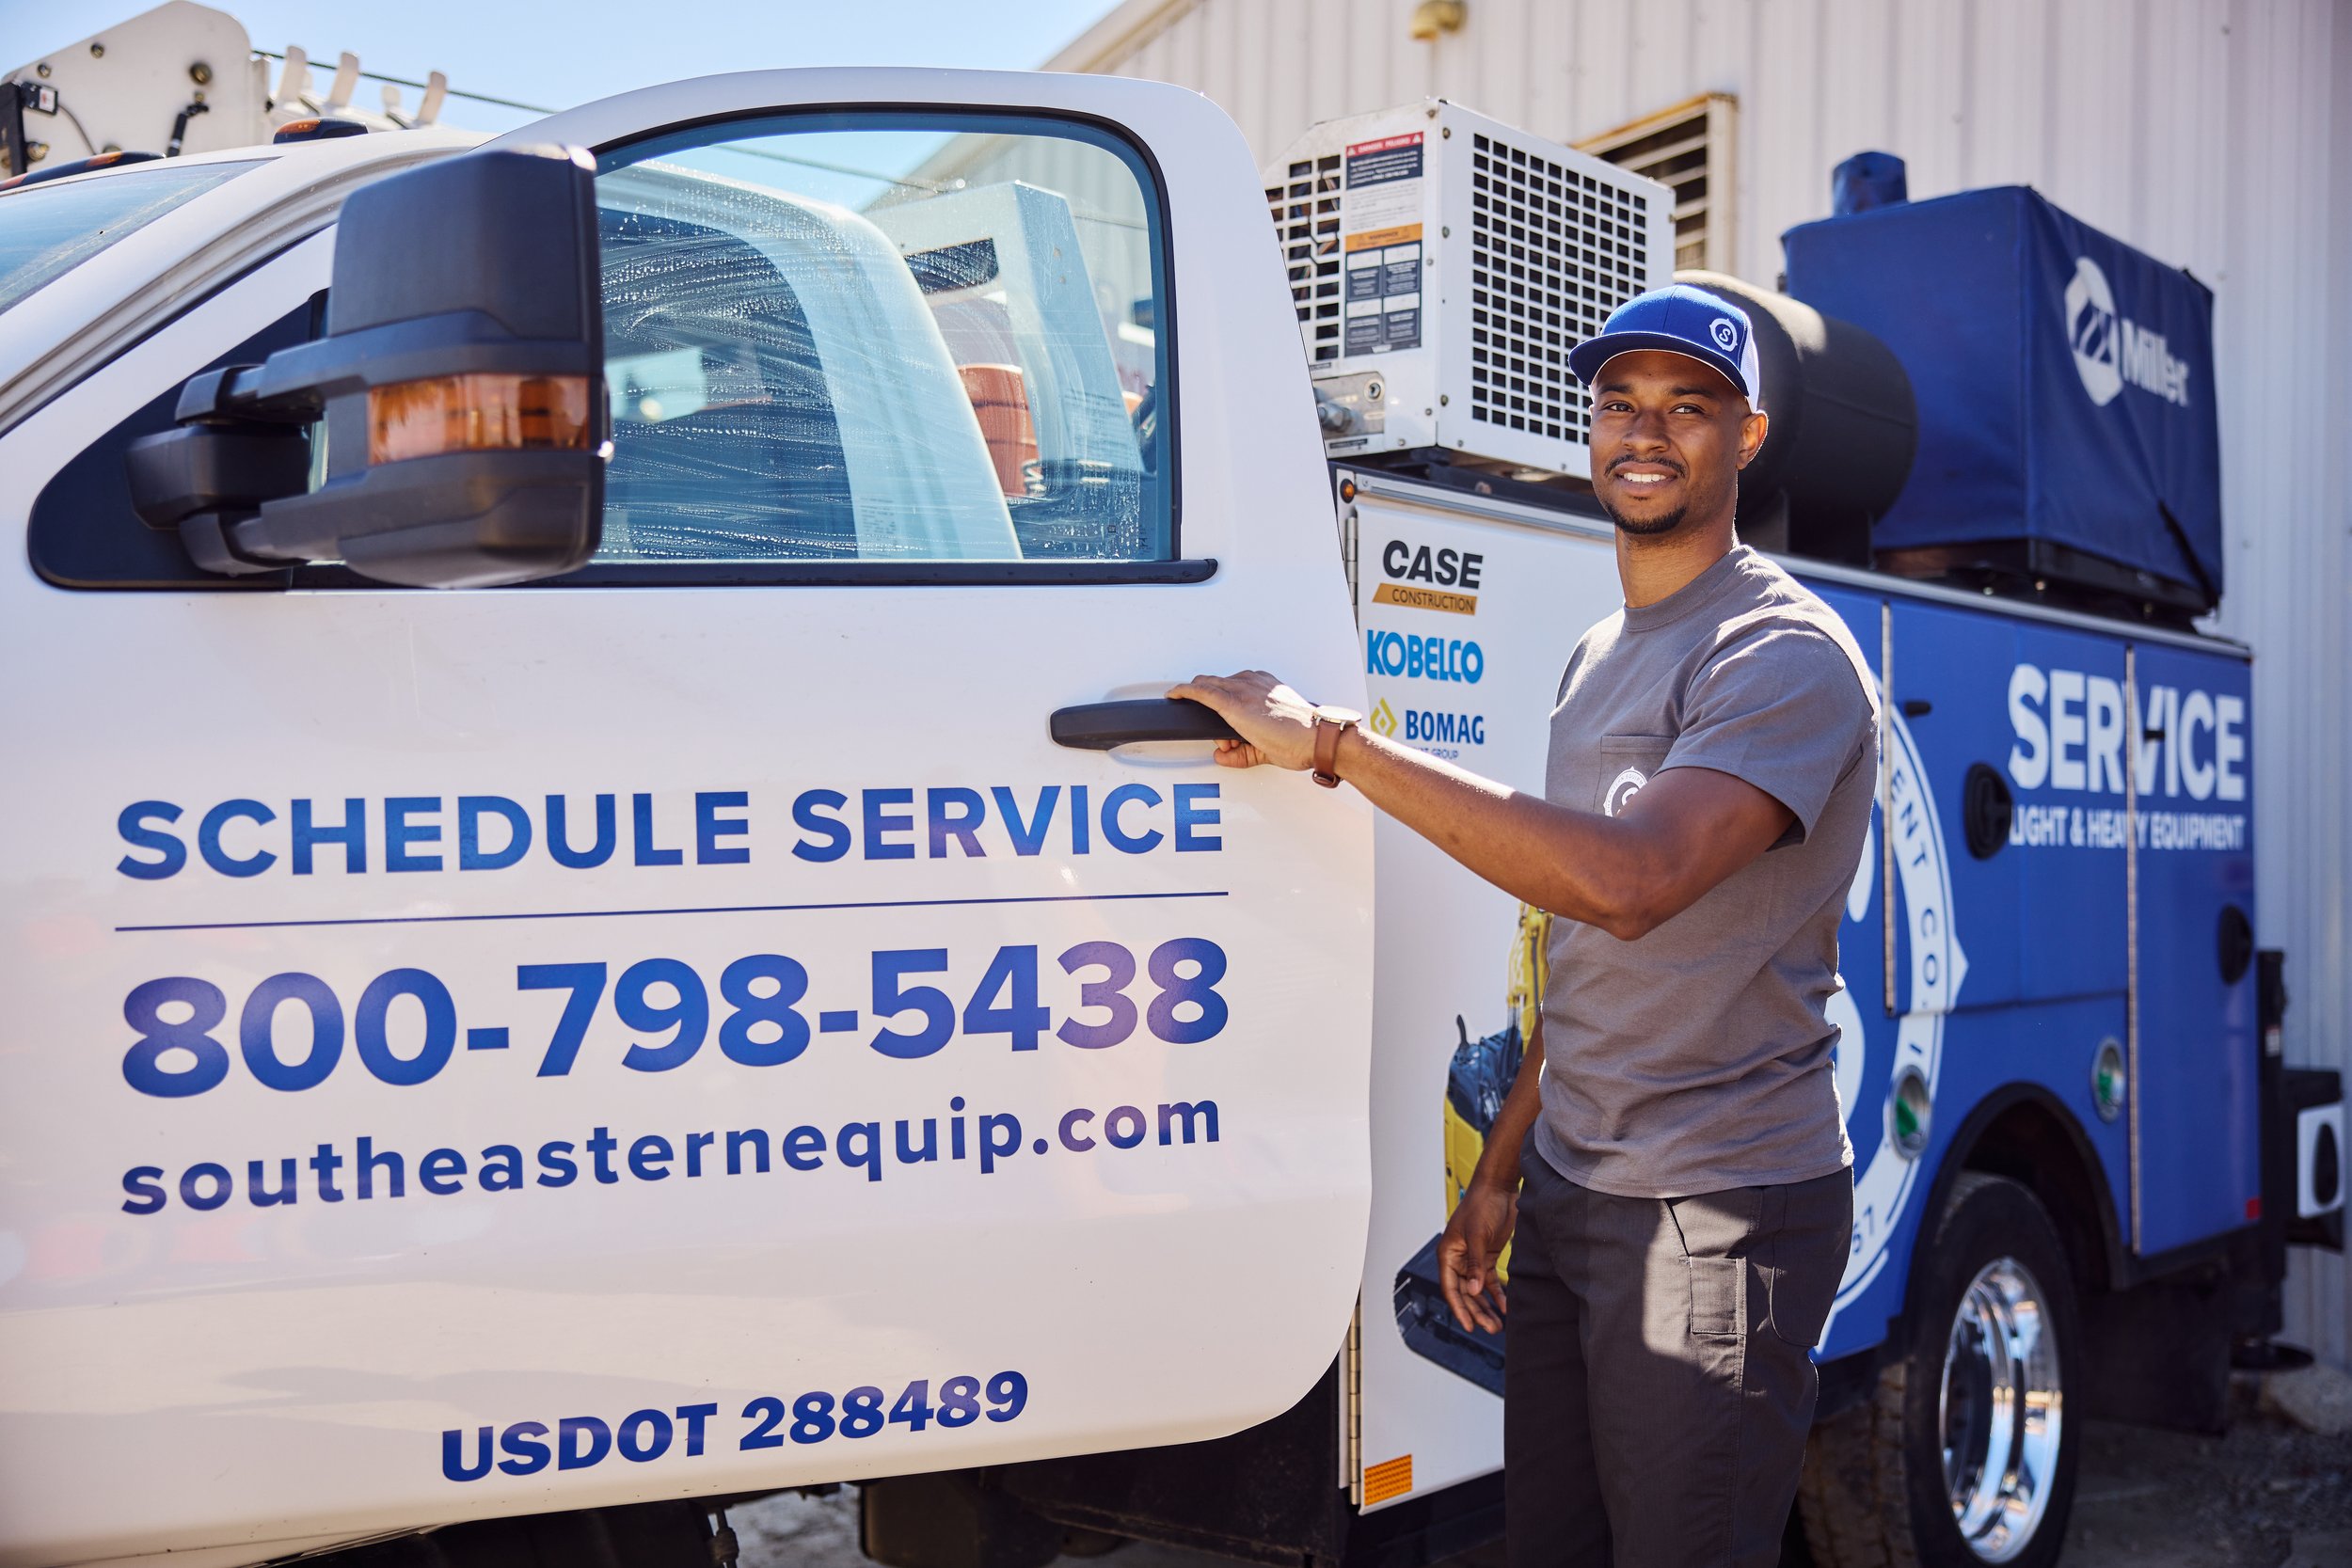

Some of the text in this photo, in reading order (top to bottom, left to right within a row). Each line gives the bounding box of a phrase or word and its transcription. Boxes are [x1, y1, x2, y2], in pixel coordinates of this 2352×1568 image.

[2121, 318, 2188, 406] Miller
[1382, 540, 1484, 590] CASE
[1391, 588, 1475, 612] CONSTRUCTION
[1367, 629, 1484, 684] KOBELCO
[1406, 709, 1485, 745] BOMAG
[2008, 663, 2245, 801] SERVICE
[117, 783, 1222, 880] SCHEDULE SERVICE
[2070, 806, 2085, 847] &
[2087, 808, 2149, 849] HEAY
[2150, 811, 2245, 850] EQUIPMENT
[122, 937, 1229, 1099] 800-798-5438
[121, 1096, 1220, 1215] southeasternequip.com
[442, 1370, 1028, 1481] USDOT 288489
